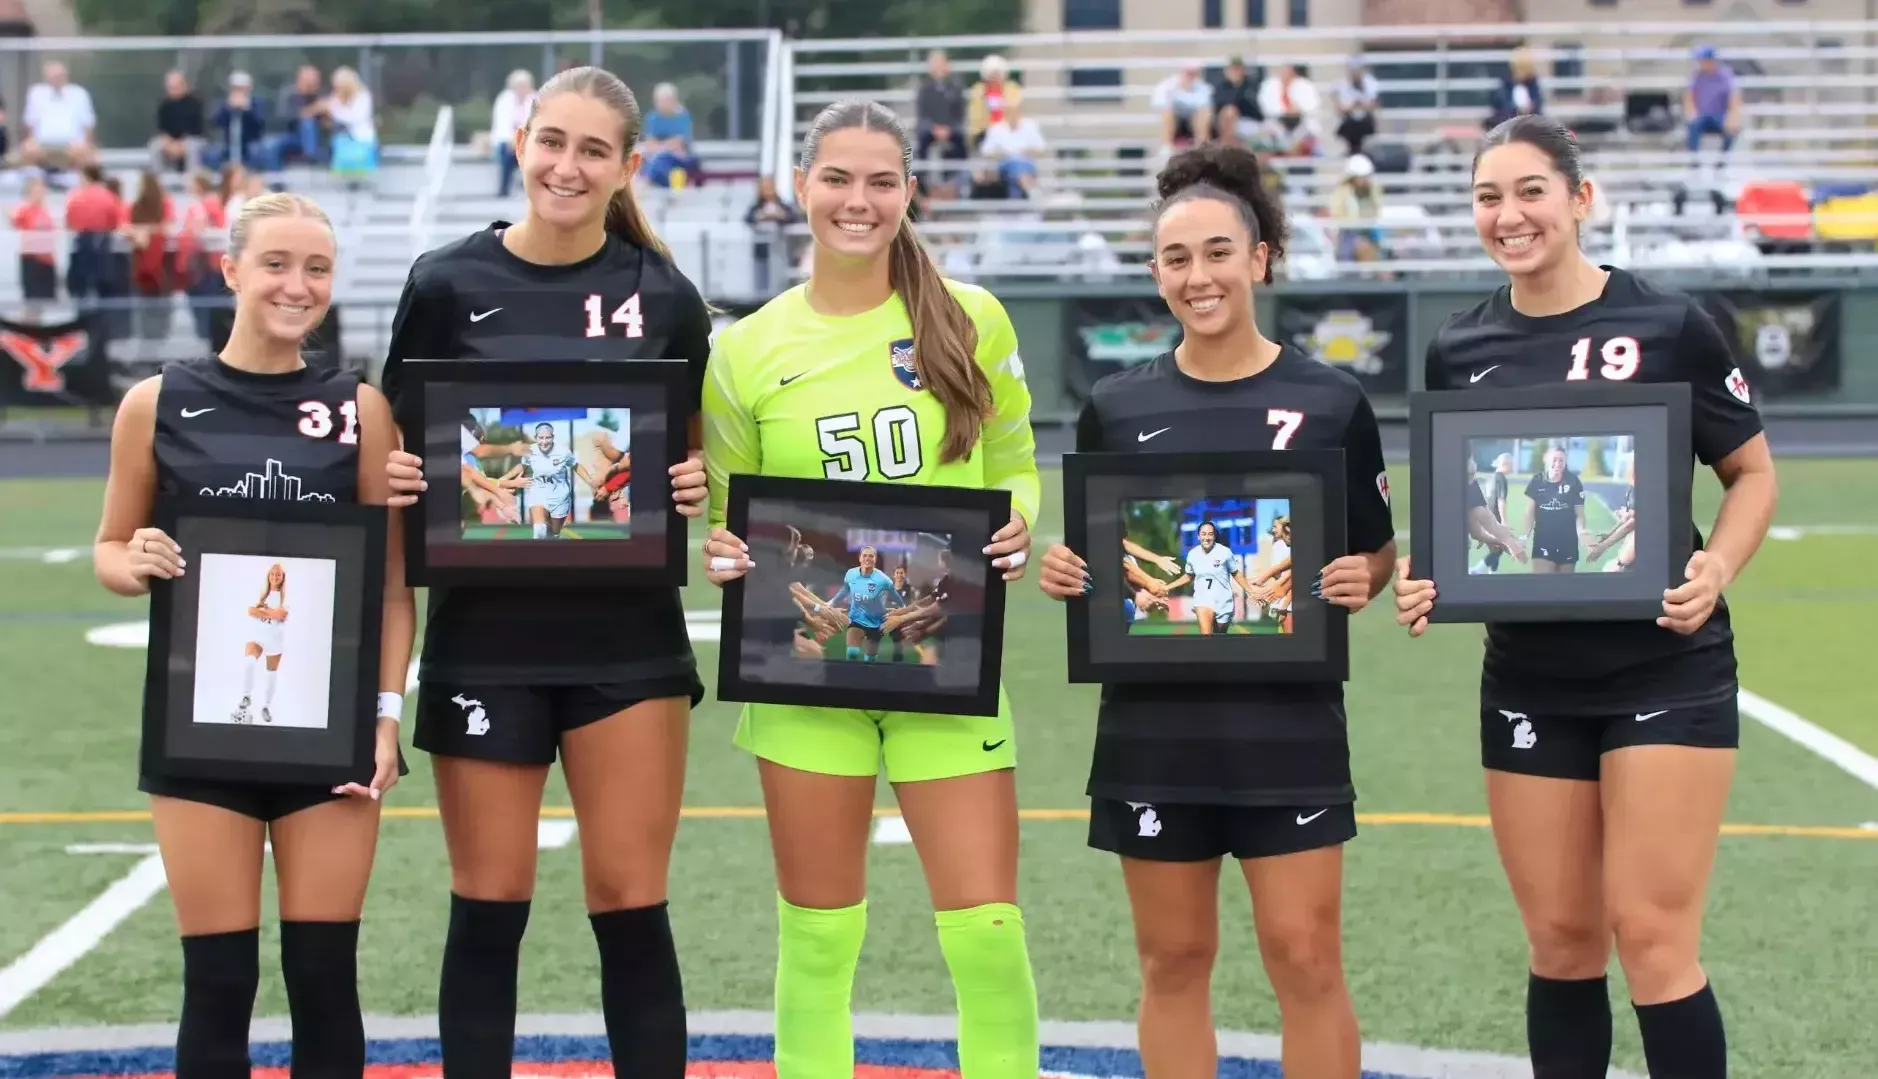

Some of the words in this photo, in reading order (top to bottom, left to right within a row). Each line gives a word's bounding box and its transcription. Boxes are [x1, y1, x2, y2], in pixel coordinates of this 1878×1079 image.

[584, 290, 644, 339] 14
[0, 331, 88, 391] Y
[1566, 335, 1642, 382] 19
[297, 399, 358, 445] 31
[815, 404, 923, 481] 50
[1266, 408, 1305, 450] 7
[854, 593, 869, 602] 50
[1205, 578, 1213, 590] 7
